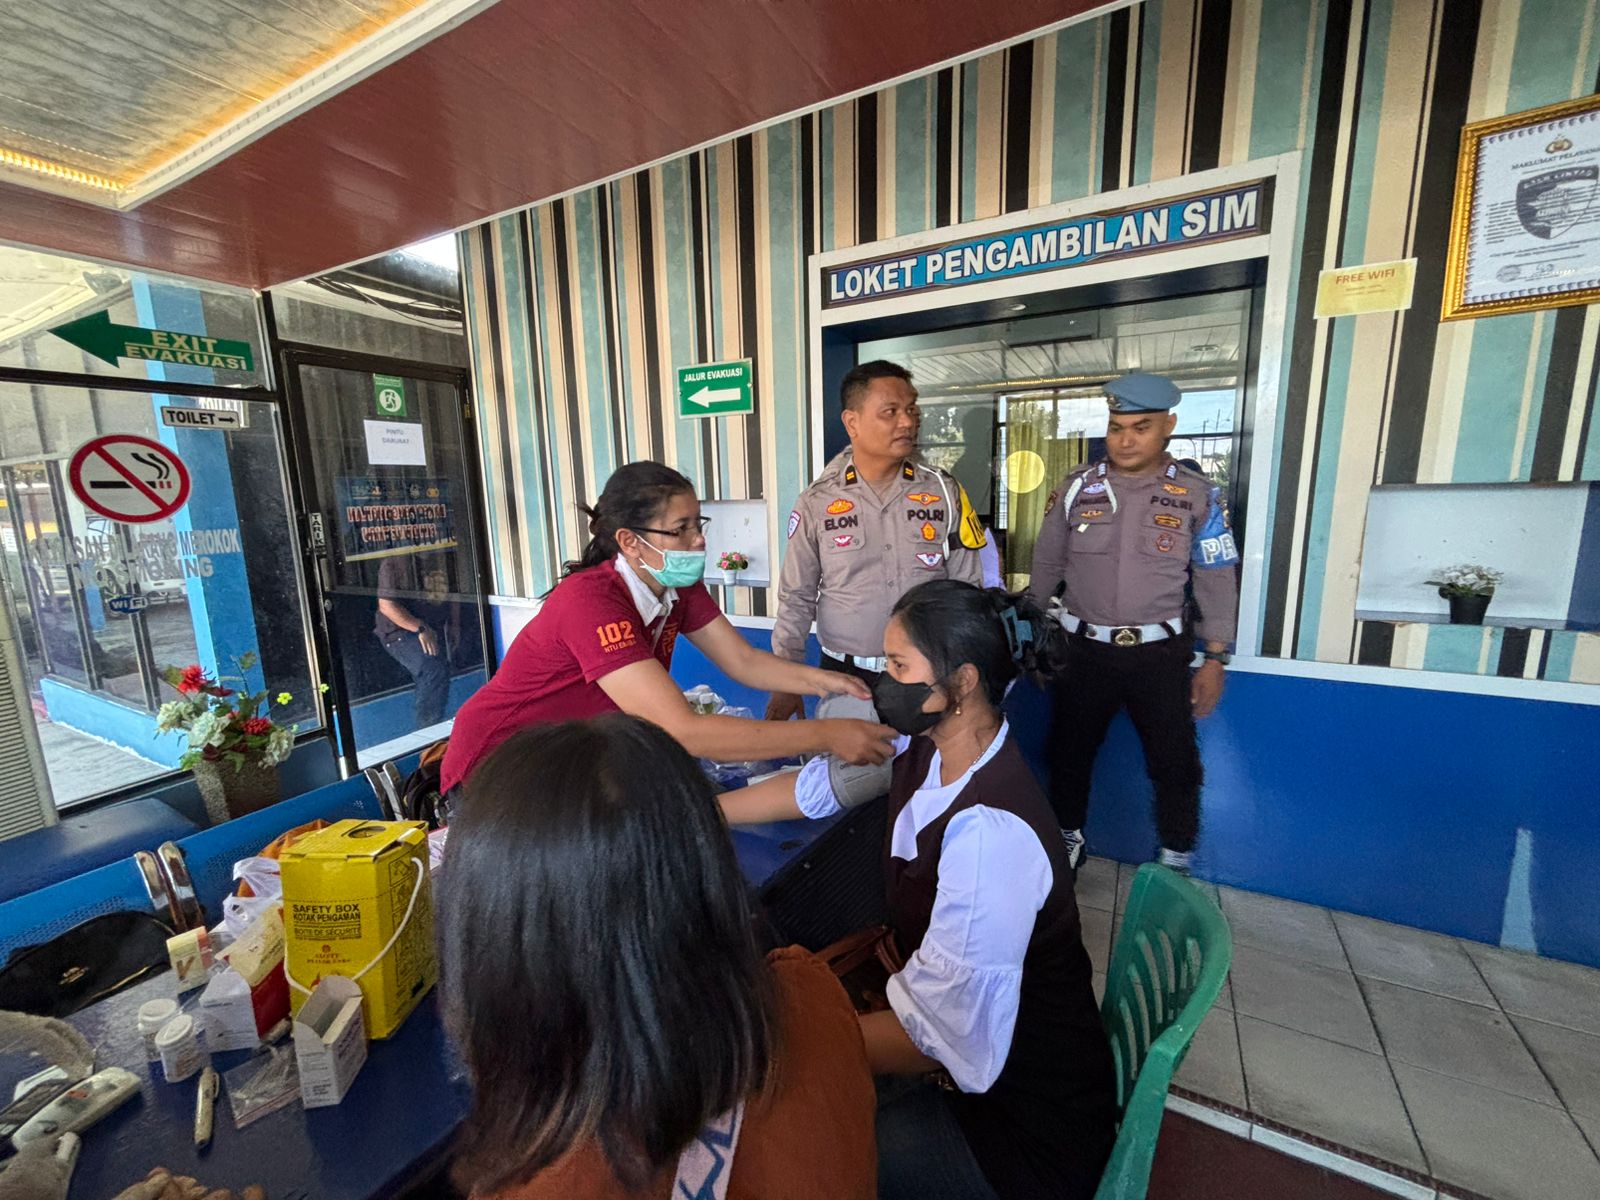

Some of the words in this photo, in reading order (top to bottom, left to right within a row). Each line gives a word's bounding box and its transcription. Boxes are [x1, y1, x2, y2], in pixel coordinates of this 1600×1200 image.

[830, 258, 918, 301] LOKET
[926, 208, 1169, 284] PENGAMBILAN
[1181, 190, 1259, 238] SIM
[1335, 272, 1365, 285] FREE
[1368, 268, 1396, 280] WIFI
[152, 331, 218, 353] EXIT
[125, 345, 248, 371] EVAKUASI
[683, 371, 706, 383] JALUR
[707, 367, 743, 379] EVAKUASI
[166, 410, 217, 425] TOILET
[1150, 495, 1193, 511] POLRI
[824, 514, 859, 531] ELON
[907, 509, 944, 521] POLRI
[311, 514, 325, 545] TARIK
[180, 529, 242, 560] MEROKOK
[597, 620, 635, 647] 102
[292, 904, 332, 914] SAFETY
[335, 904, 360, 913] BOX
[293, 913, 316, 921] KOTAK
[317, 912, 361, 922] PENGAMAN
